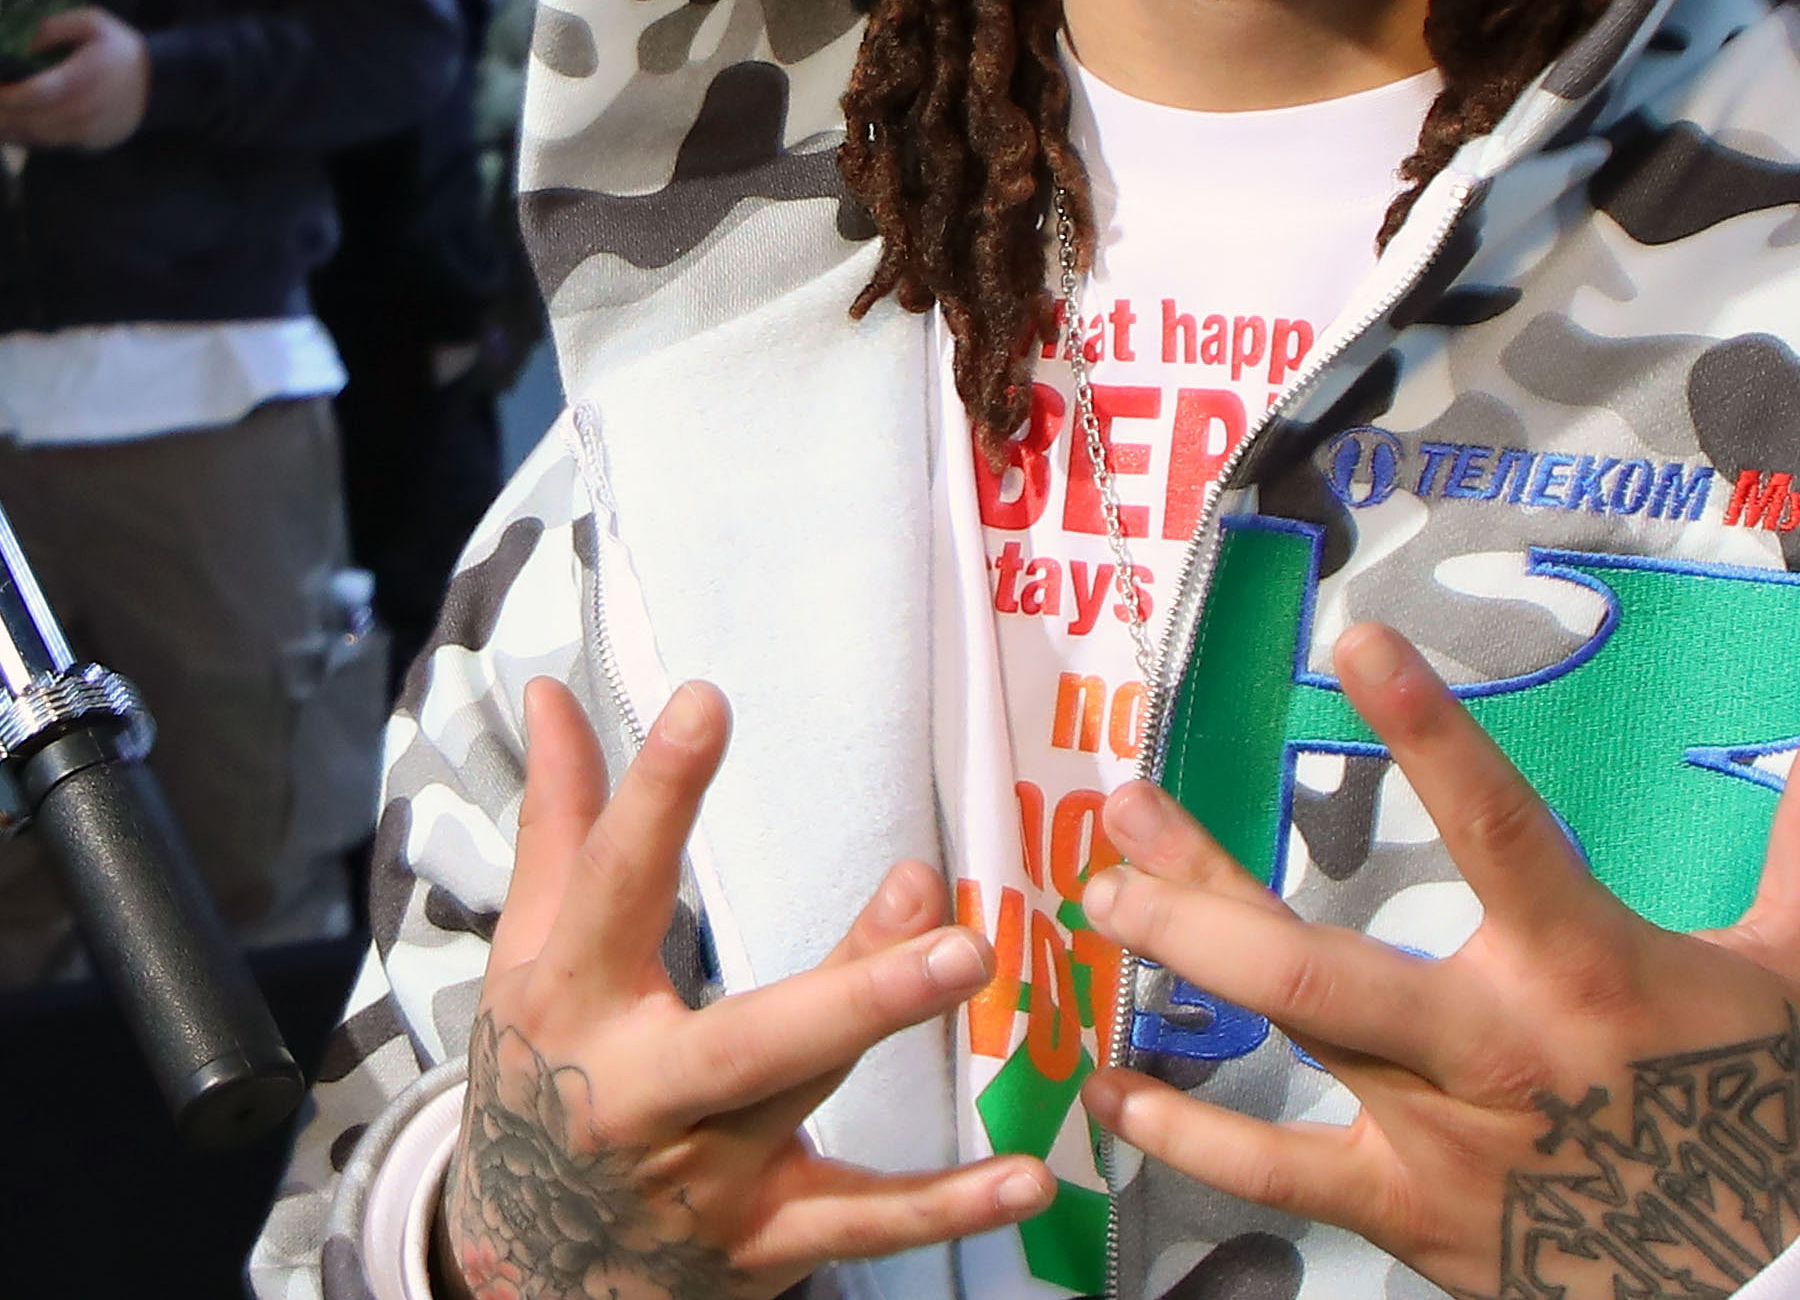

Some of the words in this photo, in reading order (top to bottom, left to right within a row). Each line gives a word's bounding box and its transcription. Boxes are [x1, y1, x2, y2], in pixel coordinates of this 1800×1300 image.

[1161, 298, 1317, 385] happ
[1414, 440, 1714, 522] ТЕЛЕКОМ
[986, 540, 1156, 636] tays
